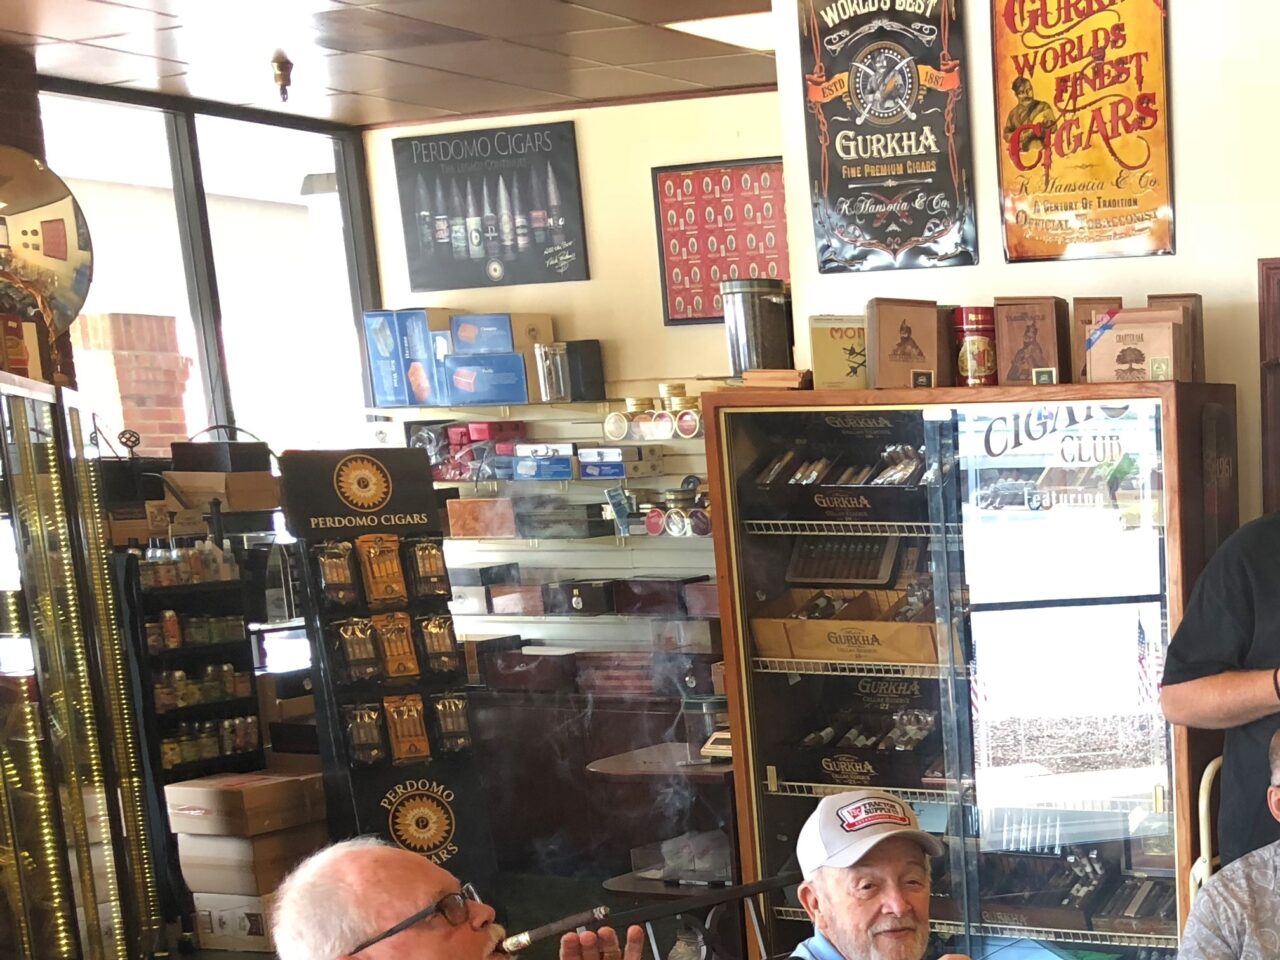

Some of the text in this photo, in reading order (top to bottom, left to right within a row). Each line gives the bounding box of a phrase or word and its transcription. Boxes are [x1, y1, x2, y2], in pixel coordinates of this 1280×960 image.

[1003, 0, 1126, 33] GURK
[1011, 23, 1126, 78] WORLDS
[923, 71, 944, 87] 1887
[822, 78, 845, 98] ESTD
[1006, 92, 1158, 174] CIGARS
[411, 131, 553, 163] PERDOMO CIGARS
[835, 126, 940, 160] GURKHA
[842, 160, 937, 178] FINE PREMIUM CIGARS
[1096, 196, 1138, 209] TRADITION
[830, 327, 865, 340] MON
[825, 416, 894, 428] GURKHA
[984, 404, 1130, 457] CIGA
[814, 494, 871, 508] GURKHA
[310, 513, 428, 529] PERDOMO CIGARS
[827, 632, 882, 646] GURKHA
[858, 680, 921, 695] GURKHA
[822, 758, 875, 774] GURKHA
[380, 779, 454, 810] PERDOMO
[864, 801, 897, 809] TRACTOR
[431, 842, 458, 864] ARS
